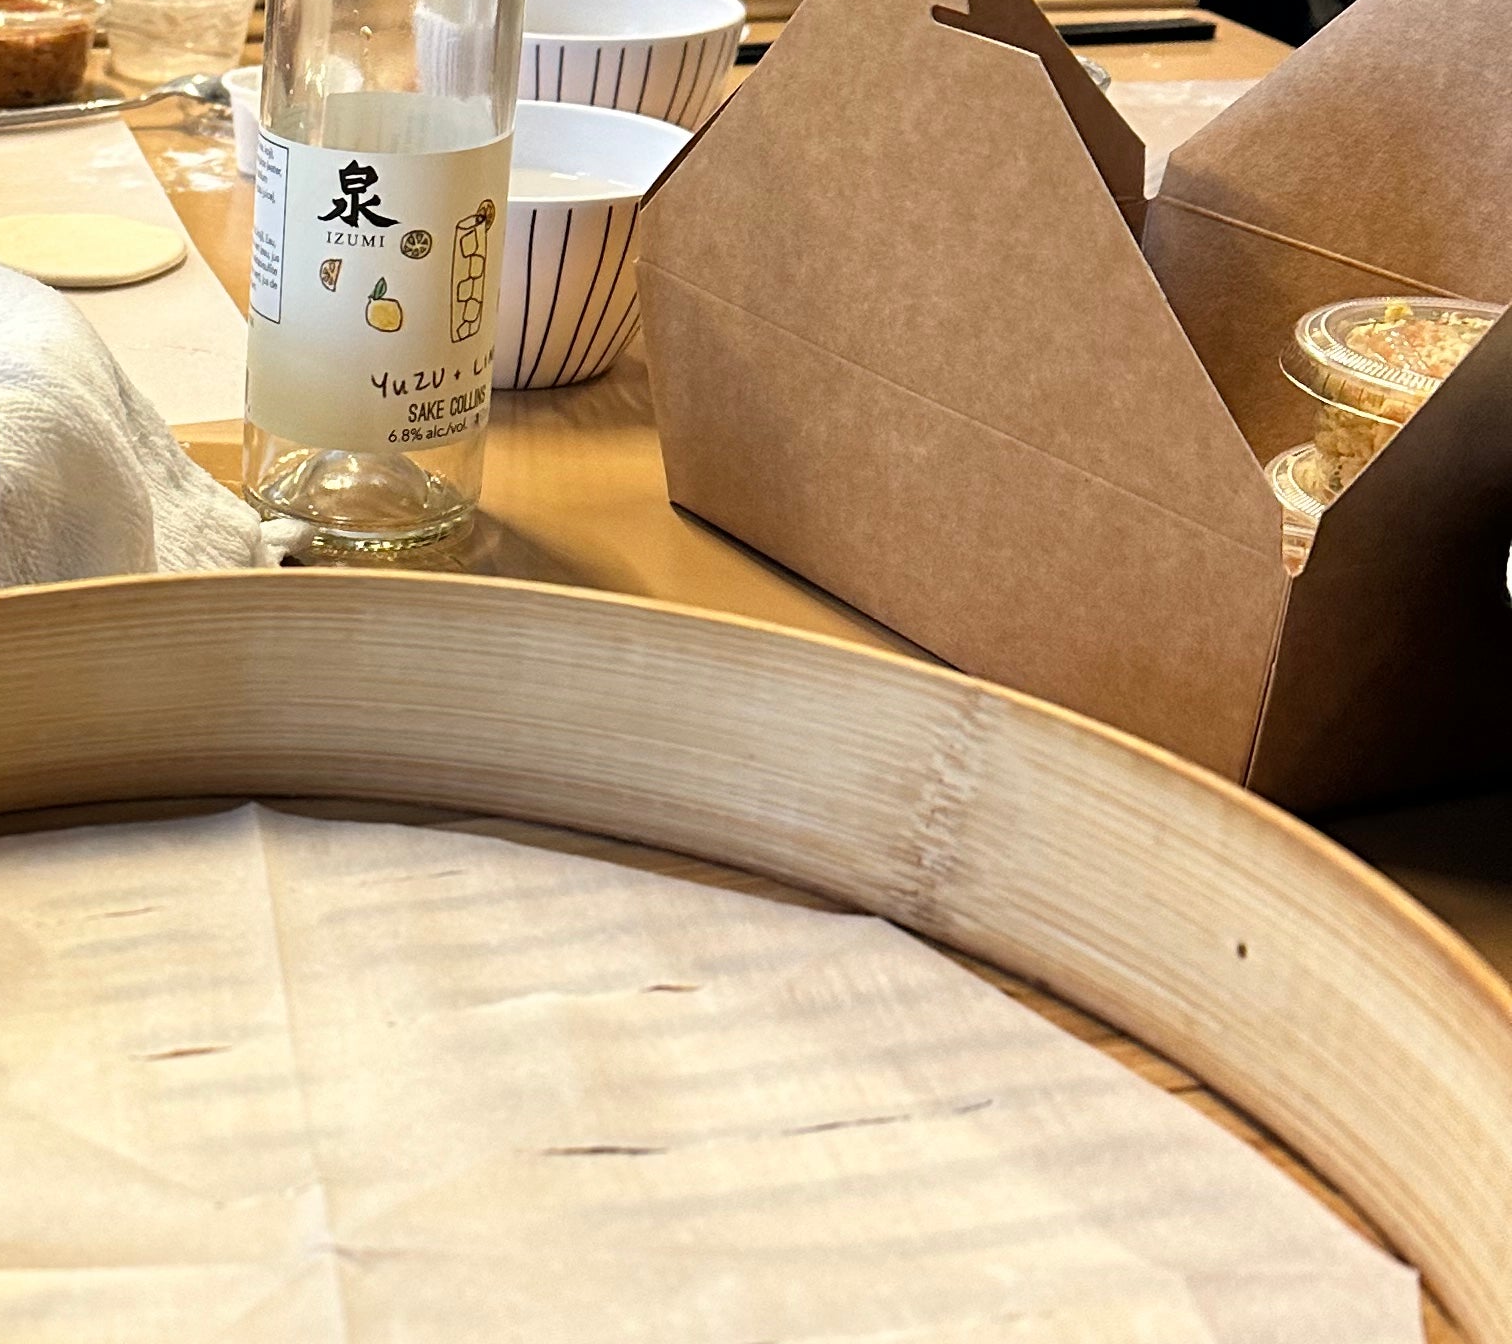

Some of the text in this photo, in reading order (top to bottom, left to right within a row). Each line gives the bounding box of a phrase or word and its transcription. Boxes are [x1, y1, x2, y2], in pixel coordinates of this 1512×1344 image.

[317, 159, 402, 228] 泉
[326, 231, 386, 248] IZUMI
[408, 399, 445, 423] SAKE
[449, 384, 486, 417] COLLINS
[388, 427, 423, 443] 6.8%
